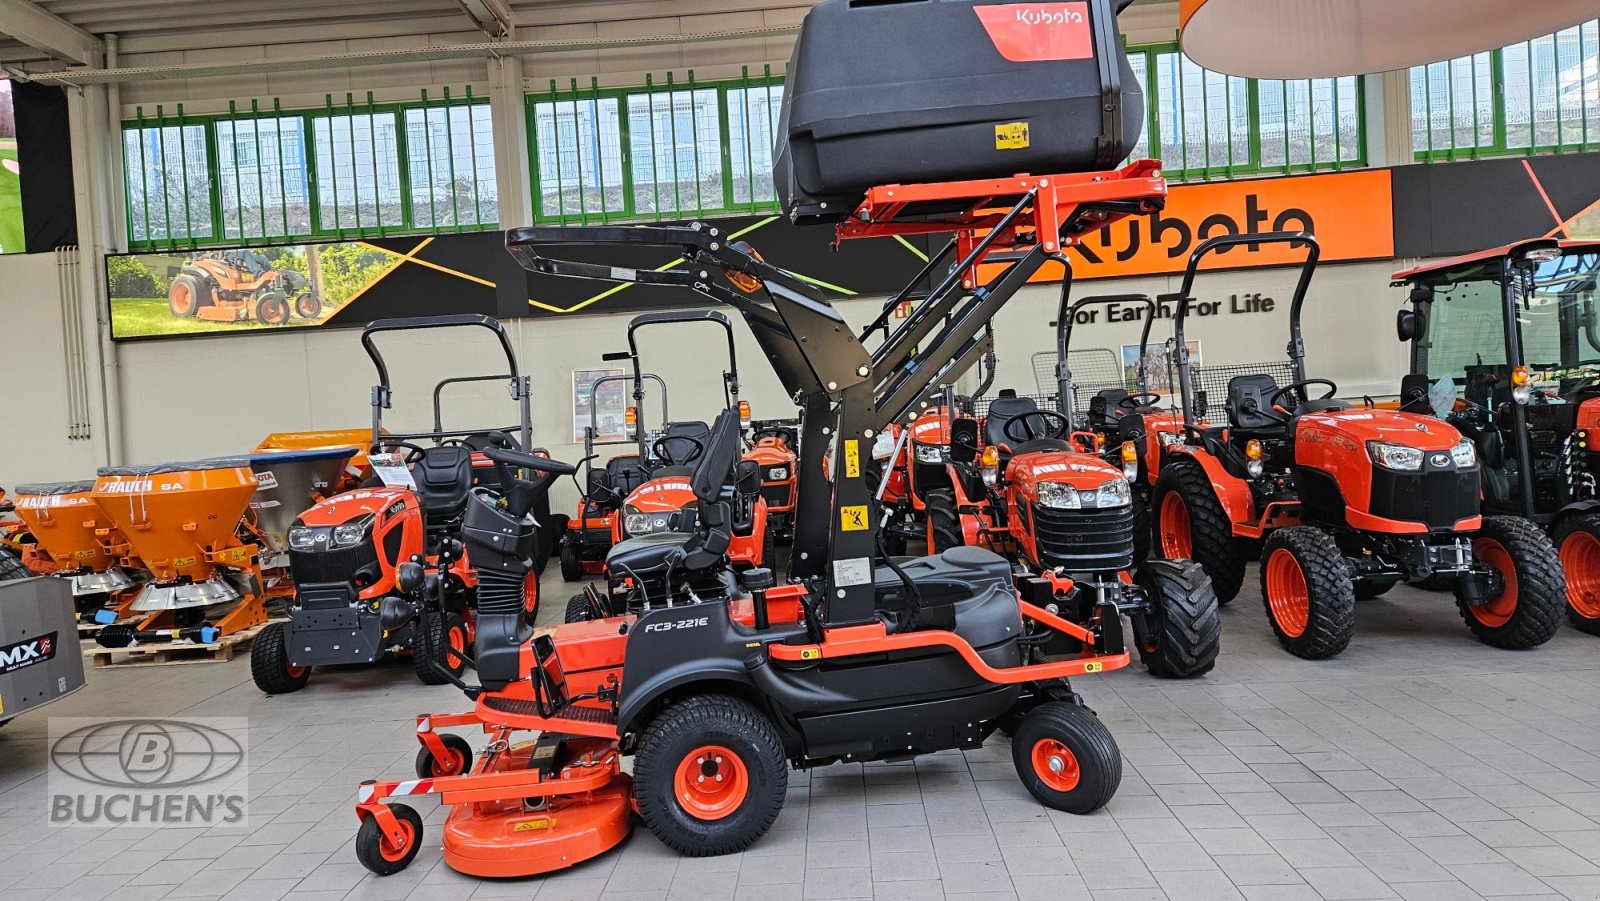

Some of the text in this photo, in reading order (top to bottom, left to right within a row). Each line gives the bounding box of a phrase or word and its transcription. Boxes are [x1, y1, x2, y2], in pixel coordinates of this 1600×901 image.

[1015, 7, 1083, 25] Kubota
[1231, 292, 1275, 315] Life
[257, 473, 273, 482] OTA
[107, 480, 184, 493] RAUCH SA
[68, 497, 88, 505] SA
[645, 616, 709, 633] FC3-221E
[0, 641, 39, 668] MX
